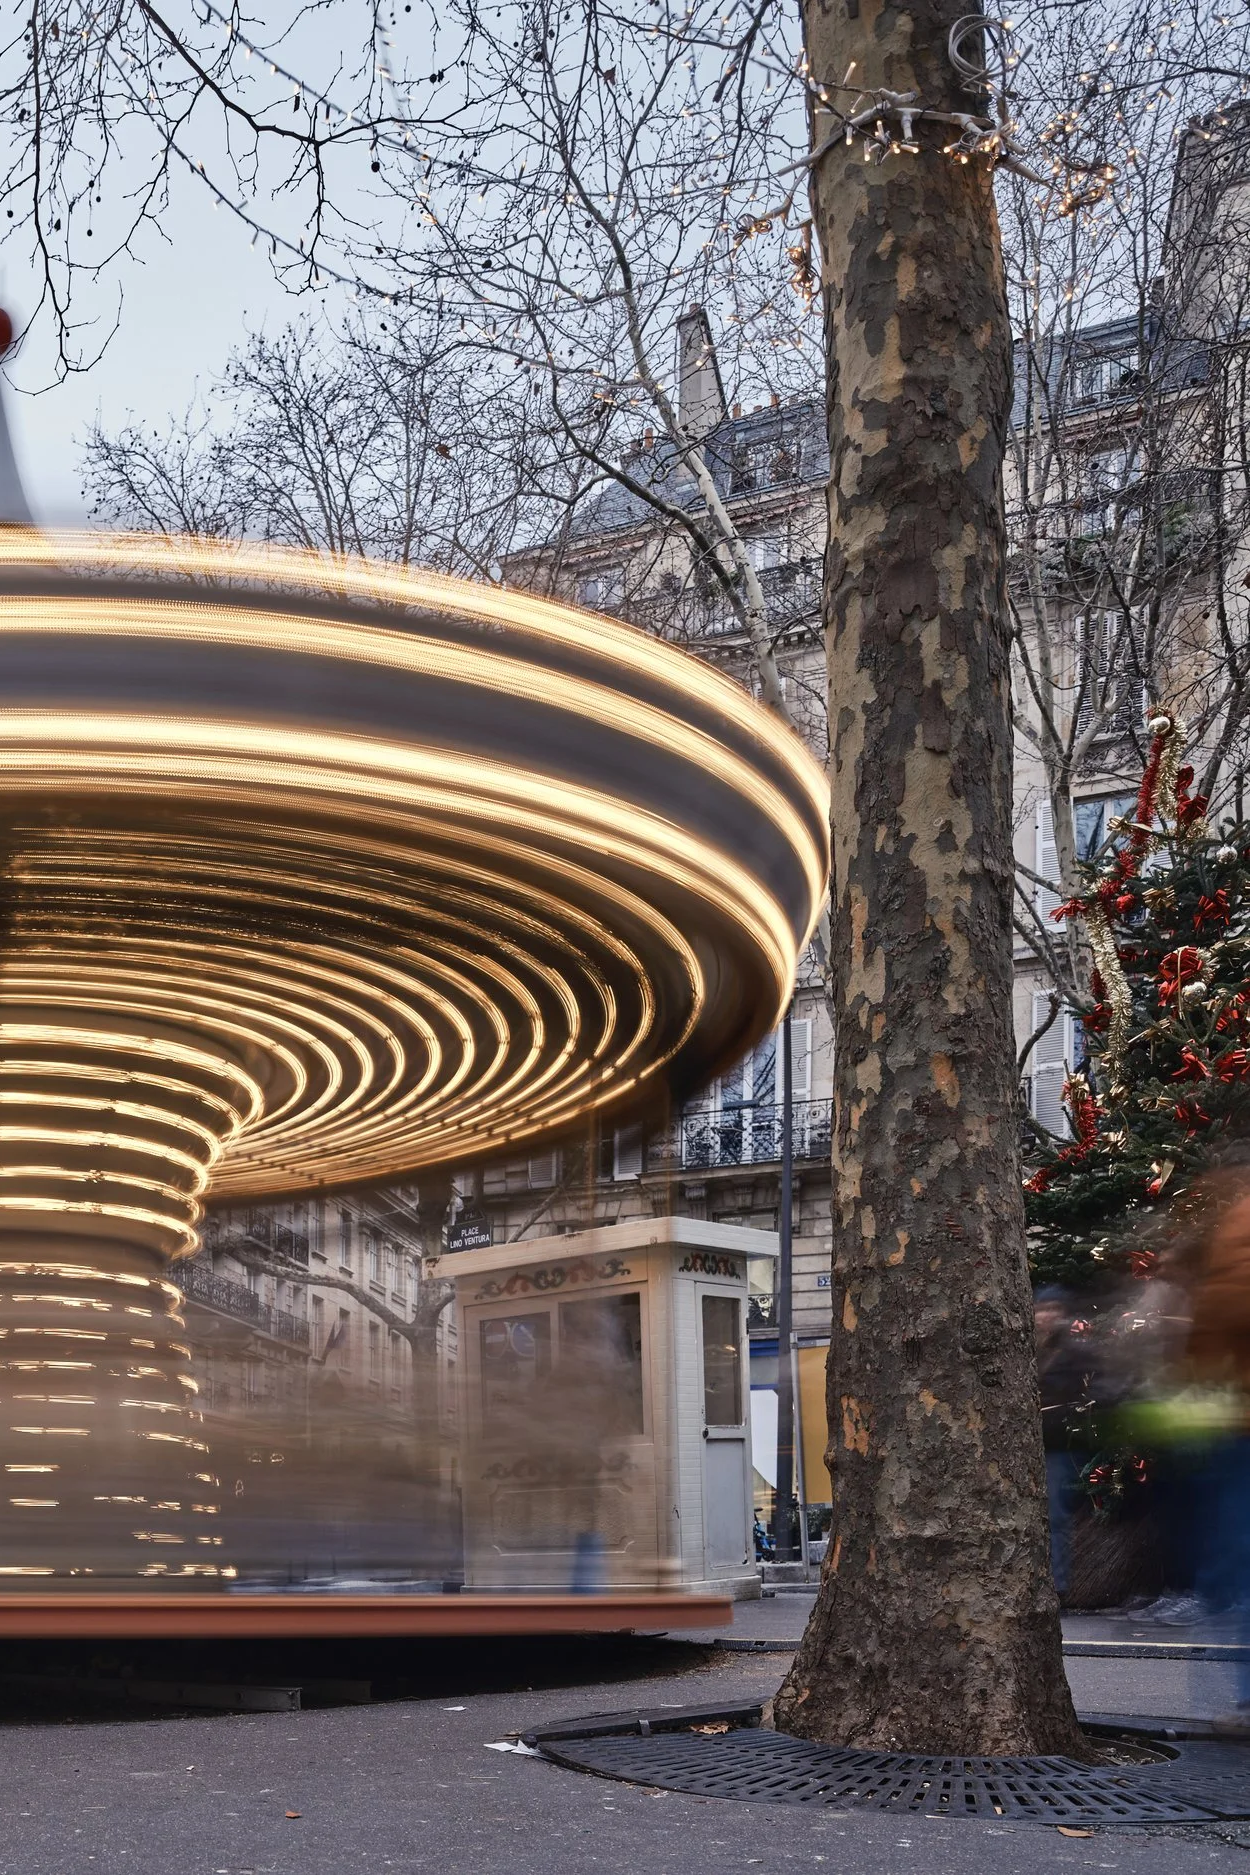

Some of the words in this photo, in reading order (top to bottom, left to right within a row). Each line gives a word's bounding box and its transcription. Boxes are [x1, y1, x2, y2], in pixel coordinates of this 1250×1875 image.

[461, 1226, 479, 1237] PLACE
[450, 1239, 463, 1248] LINO
[464, 1234, 490, 1245] VENTURA
